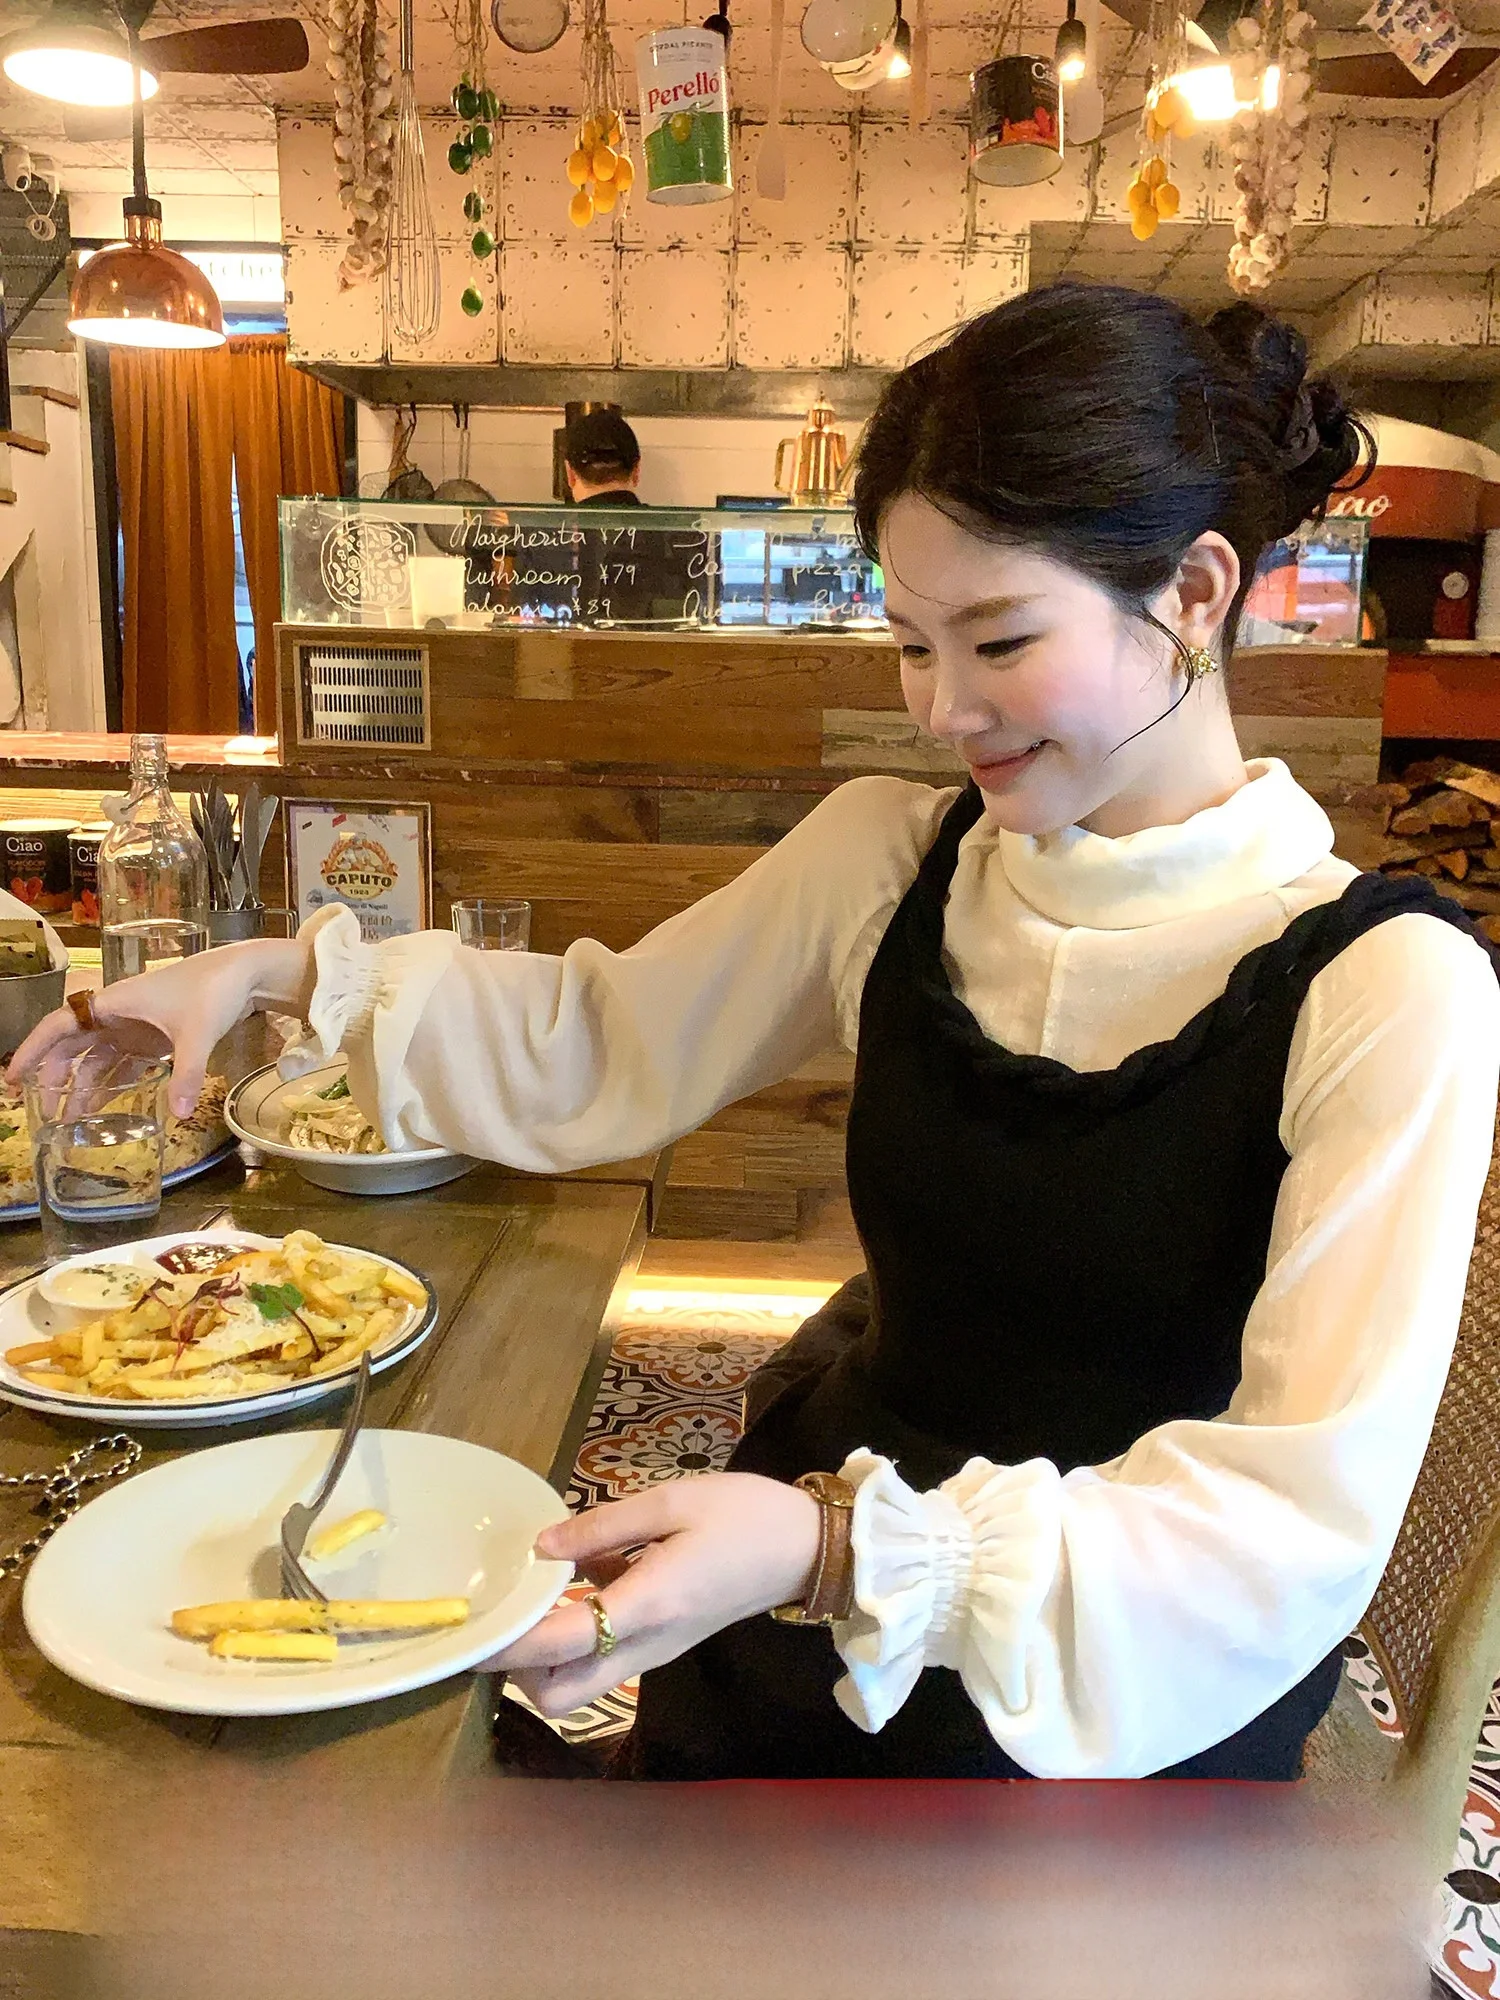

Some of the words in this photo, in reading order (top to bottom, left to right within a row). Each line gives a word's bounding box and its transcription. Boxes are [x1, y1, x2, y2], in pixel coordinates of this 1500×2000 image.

[648, 72, 719, 113] Perelló
[450, 514, 587, 562] Margherita
[600, 527, 637, 550] ¥79
[600, 564, 637, 586] ¥79
[792, 562, 864, 586] pizza
[572, 597, 612, 617] ¥89
[6, 836, 43, 853] Ciao
[77, 846, 99, 863] Cia
[326, 873, 393, 888] CAPUTO
